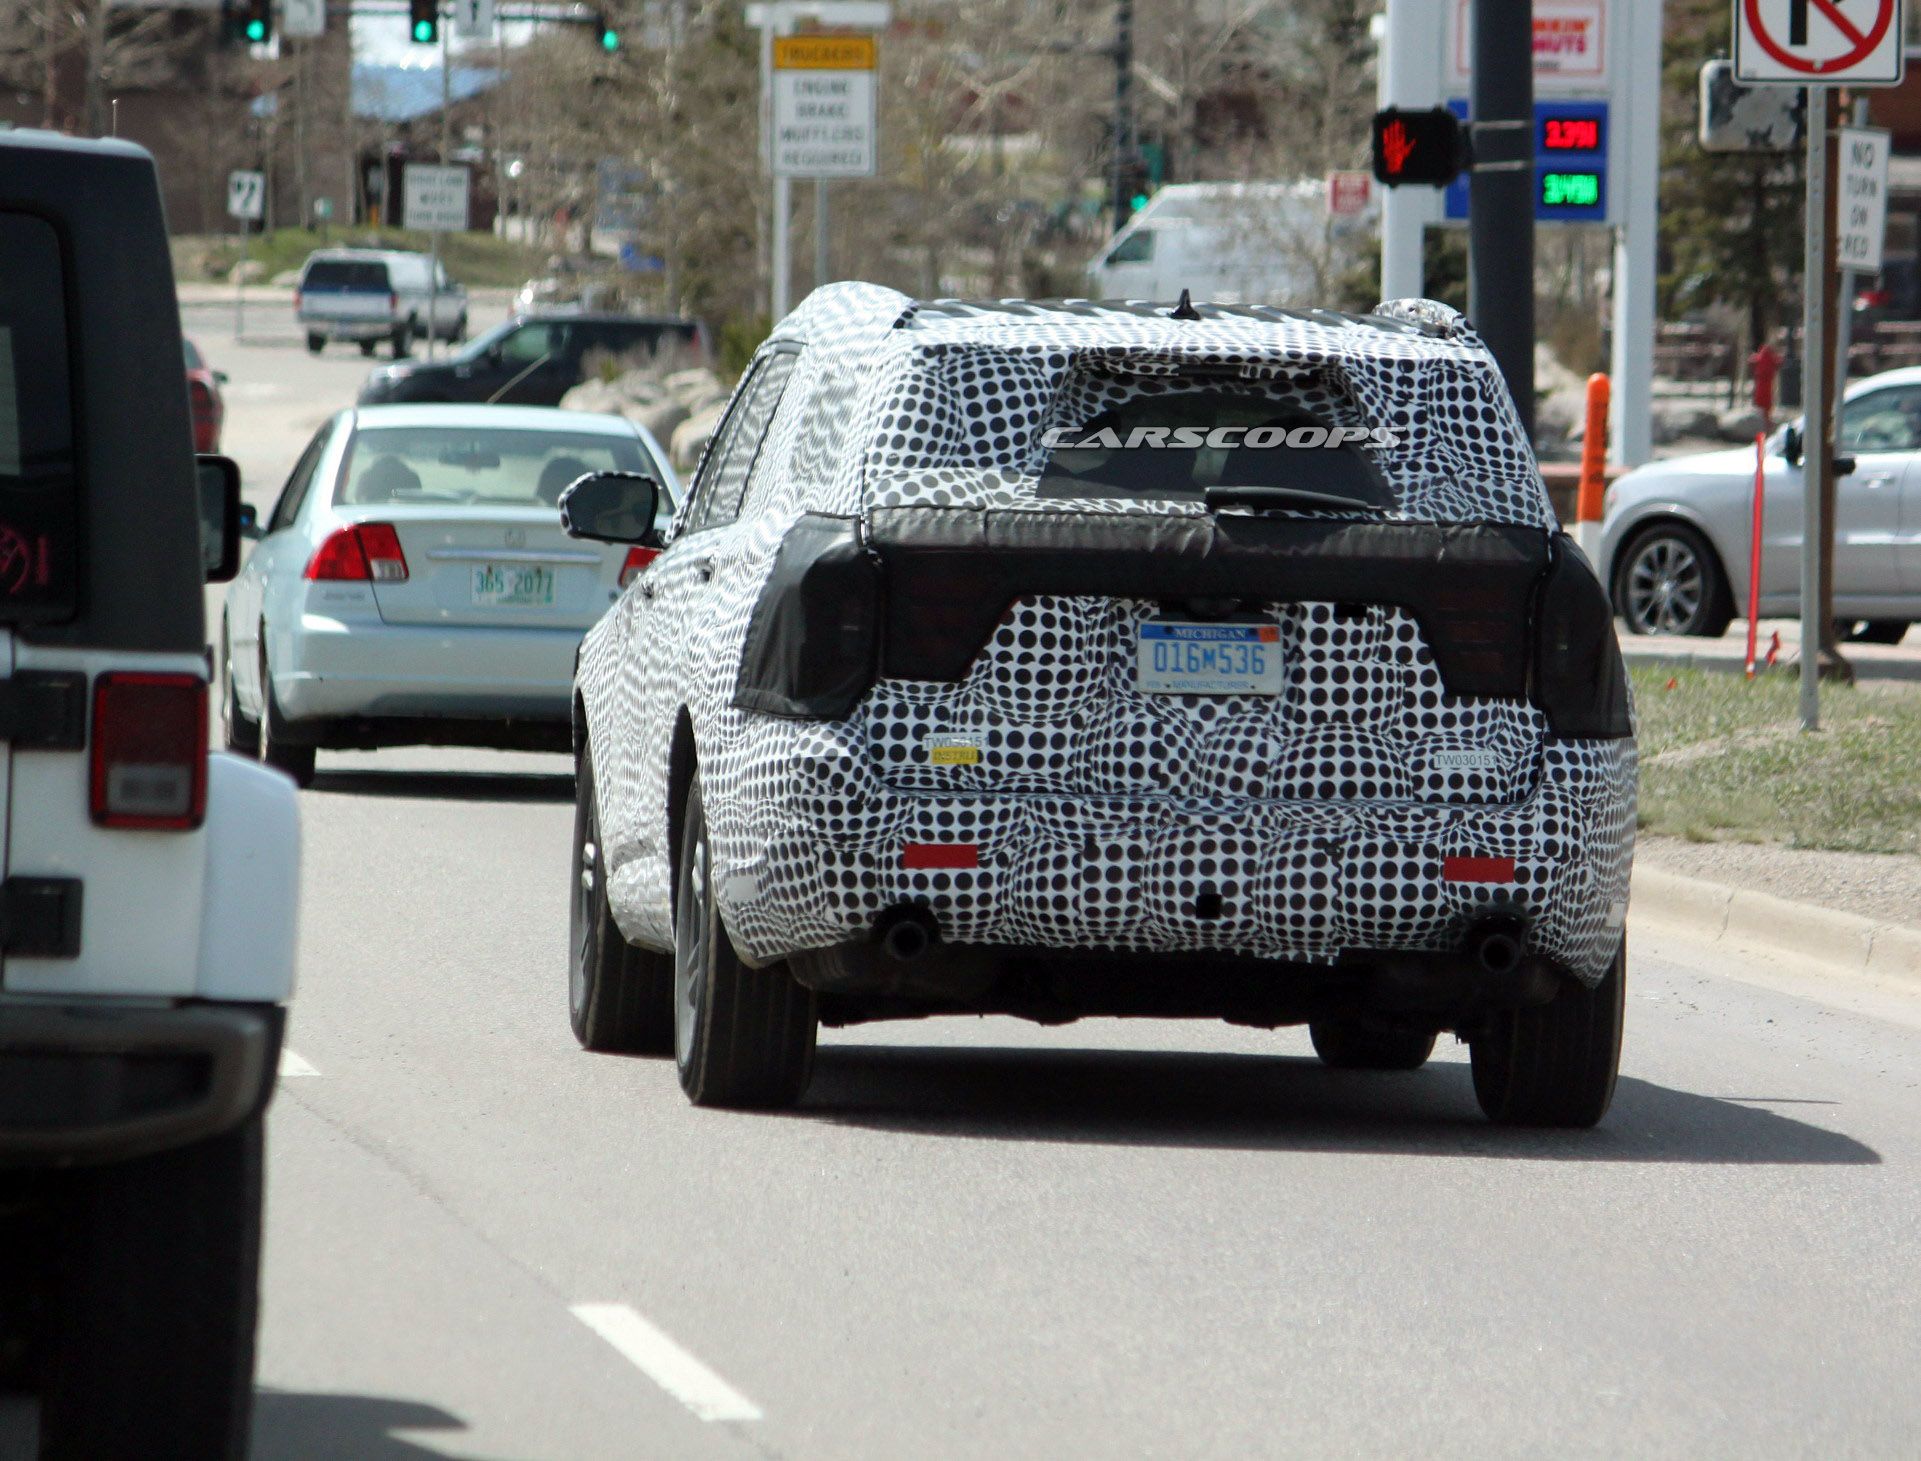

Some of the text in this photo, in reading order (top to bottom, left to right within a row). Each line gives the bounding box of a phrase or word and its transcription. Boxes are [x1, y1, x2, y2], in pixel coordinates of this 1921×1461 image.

[796, 102, 846, 117] BRAKE
[1852, 141, 1875, 170] NO
[1846, 173, 1878, 198] TURN
[1850, 204, 1869, 228] ON
[1844, 233, 1869, 259] RED
[1174, 627, 1246, 640] MICHIGAN
[1154, 642, 1265, 675] 016M536
